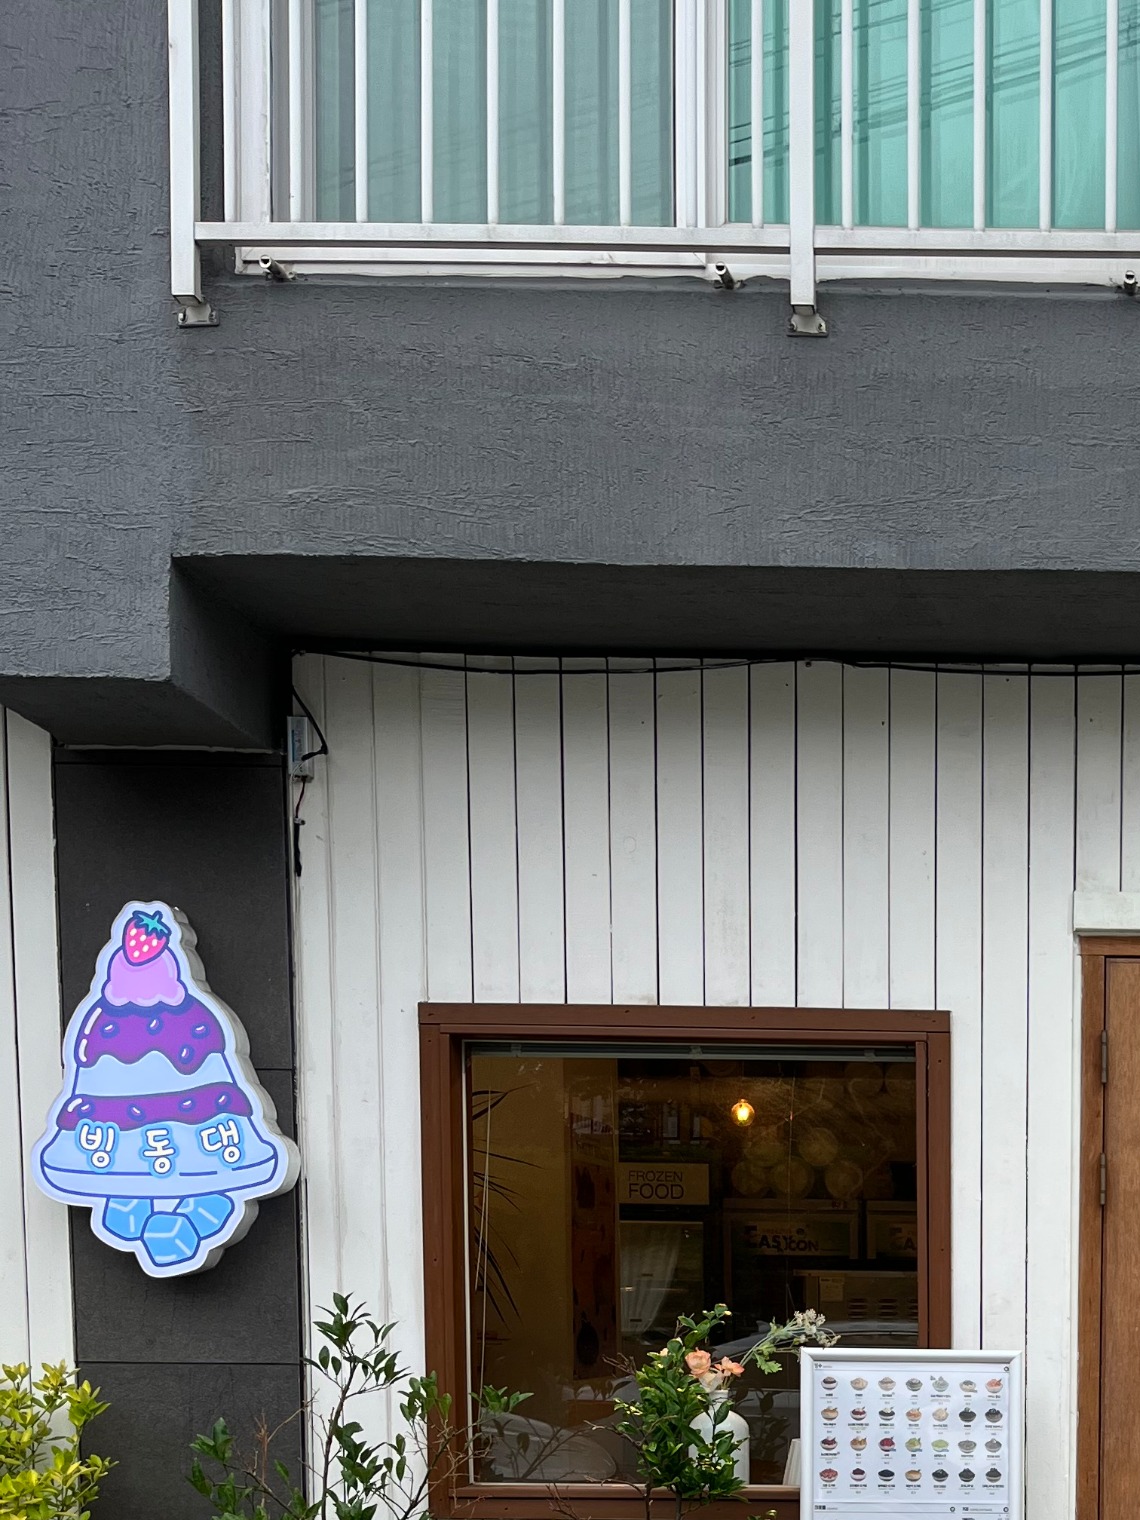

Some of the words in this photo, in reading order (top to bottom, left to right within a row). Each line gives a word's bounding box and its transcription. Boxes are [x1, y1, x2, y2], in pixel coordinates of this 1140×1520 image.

[80, 1120, 241, 1174] 빙동댕
[628, 1170, 683, 1183] FROZEN
[628, 1183, 684, 1200] FOOD
